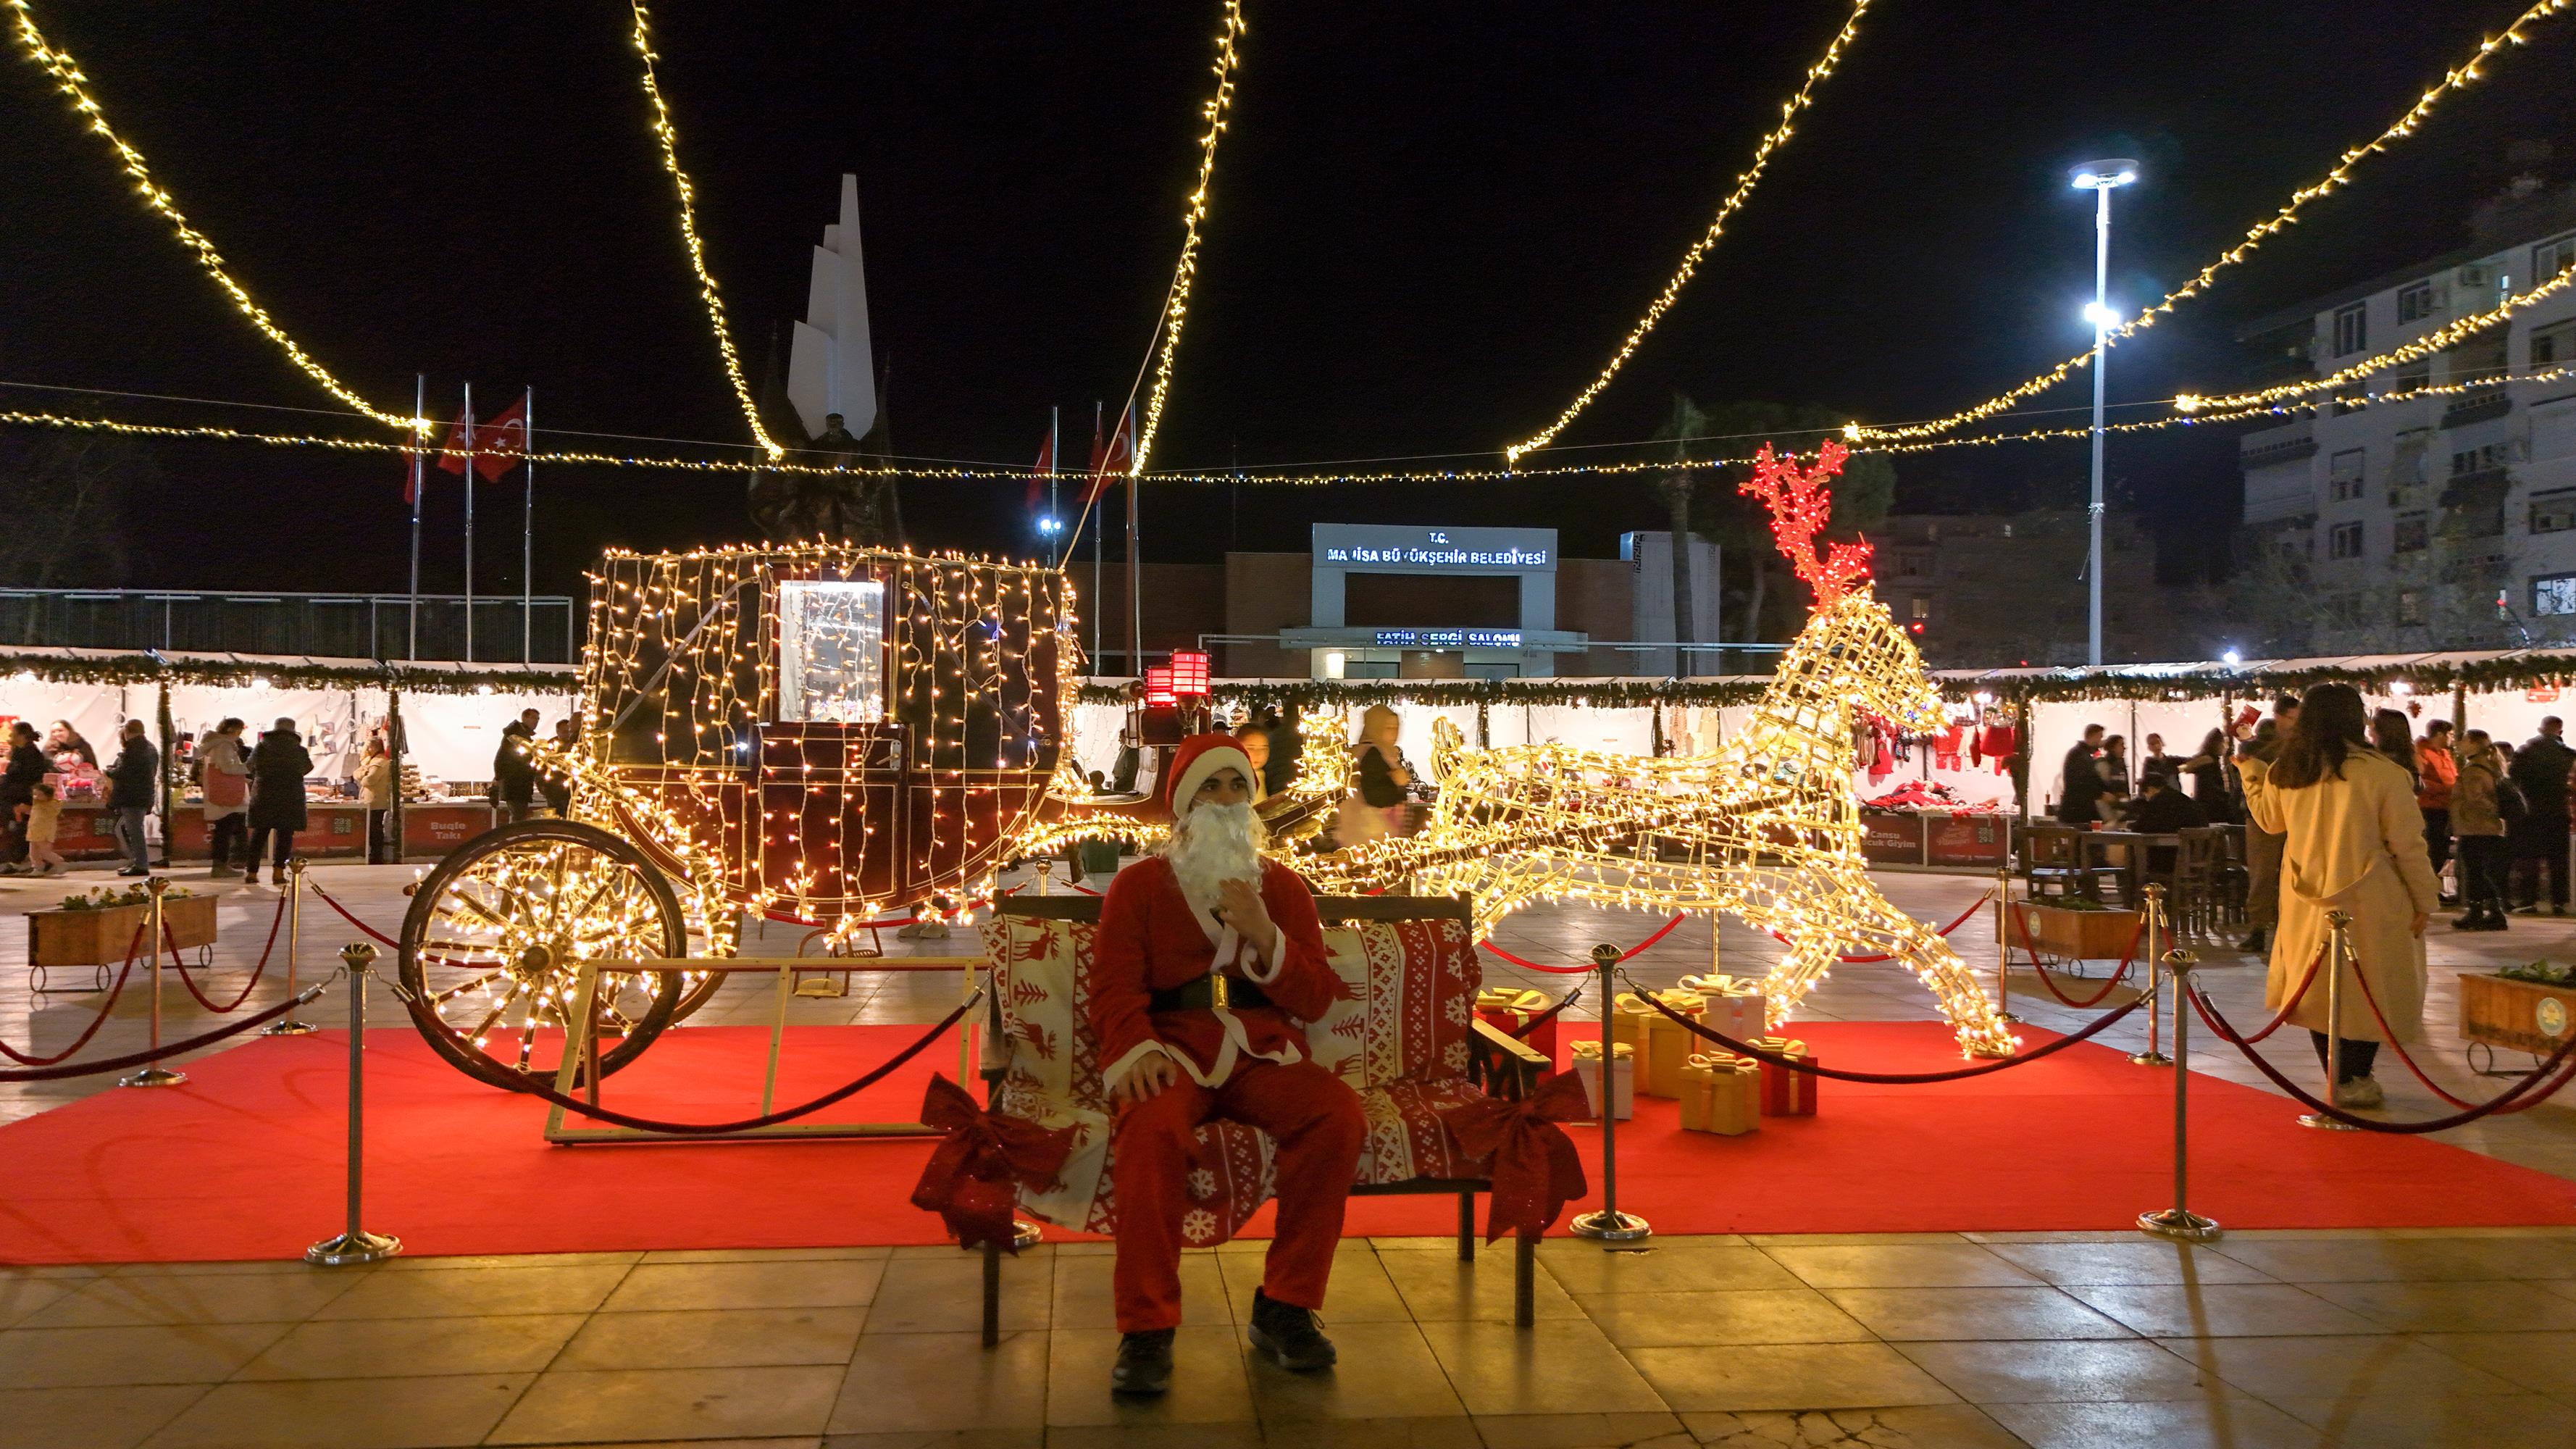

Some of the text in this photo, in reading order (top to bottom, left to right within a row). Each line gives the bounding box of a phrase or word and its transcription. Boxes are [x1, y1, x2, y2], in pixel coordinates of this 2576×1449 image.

[1429, 532, 1449, 544] T.C.
[1471, 548, 1546, 565] BELEDİYESİ
[1886, 839, 1916, 848] Giyim
